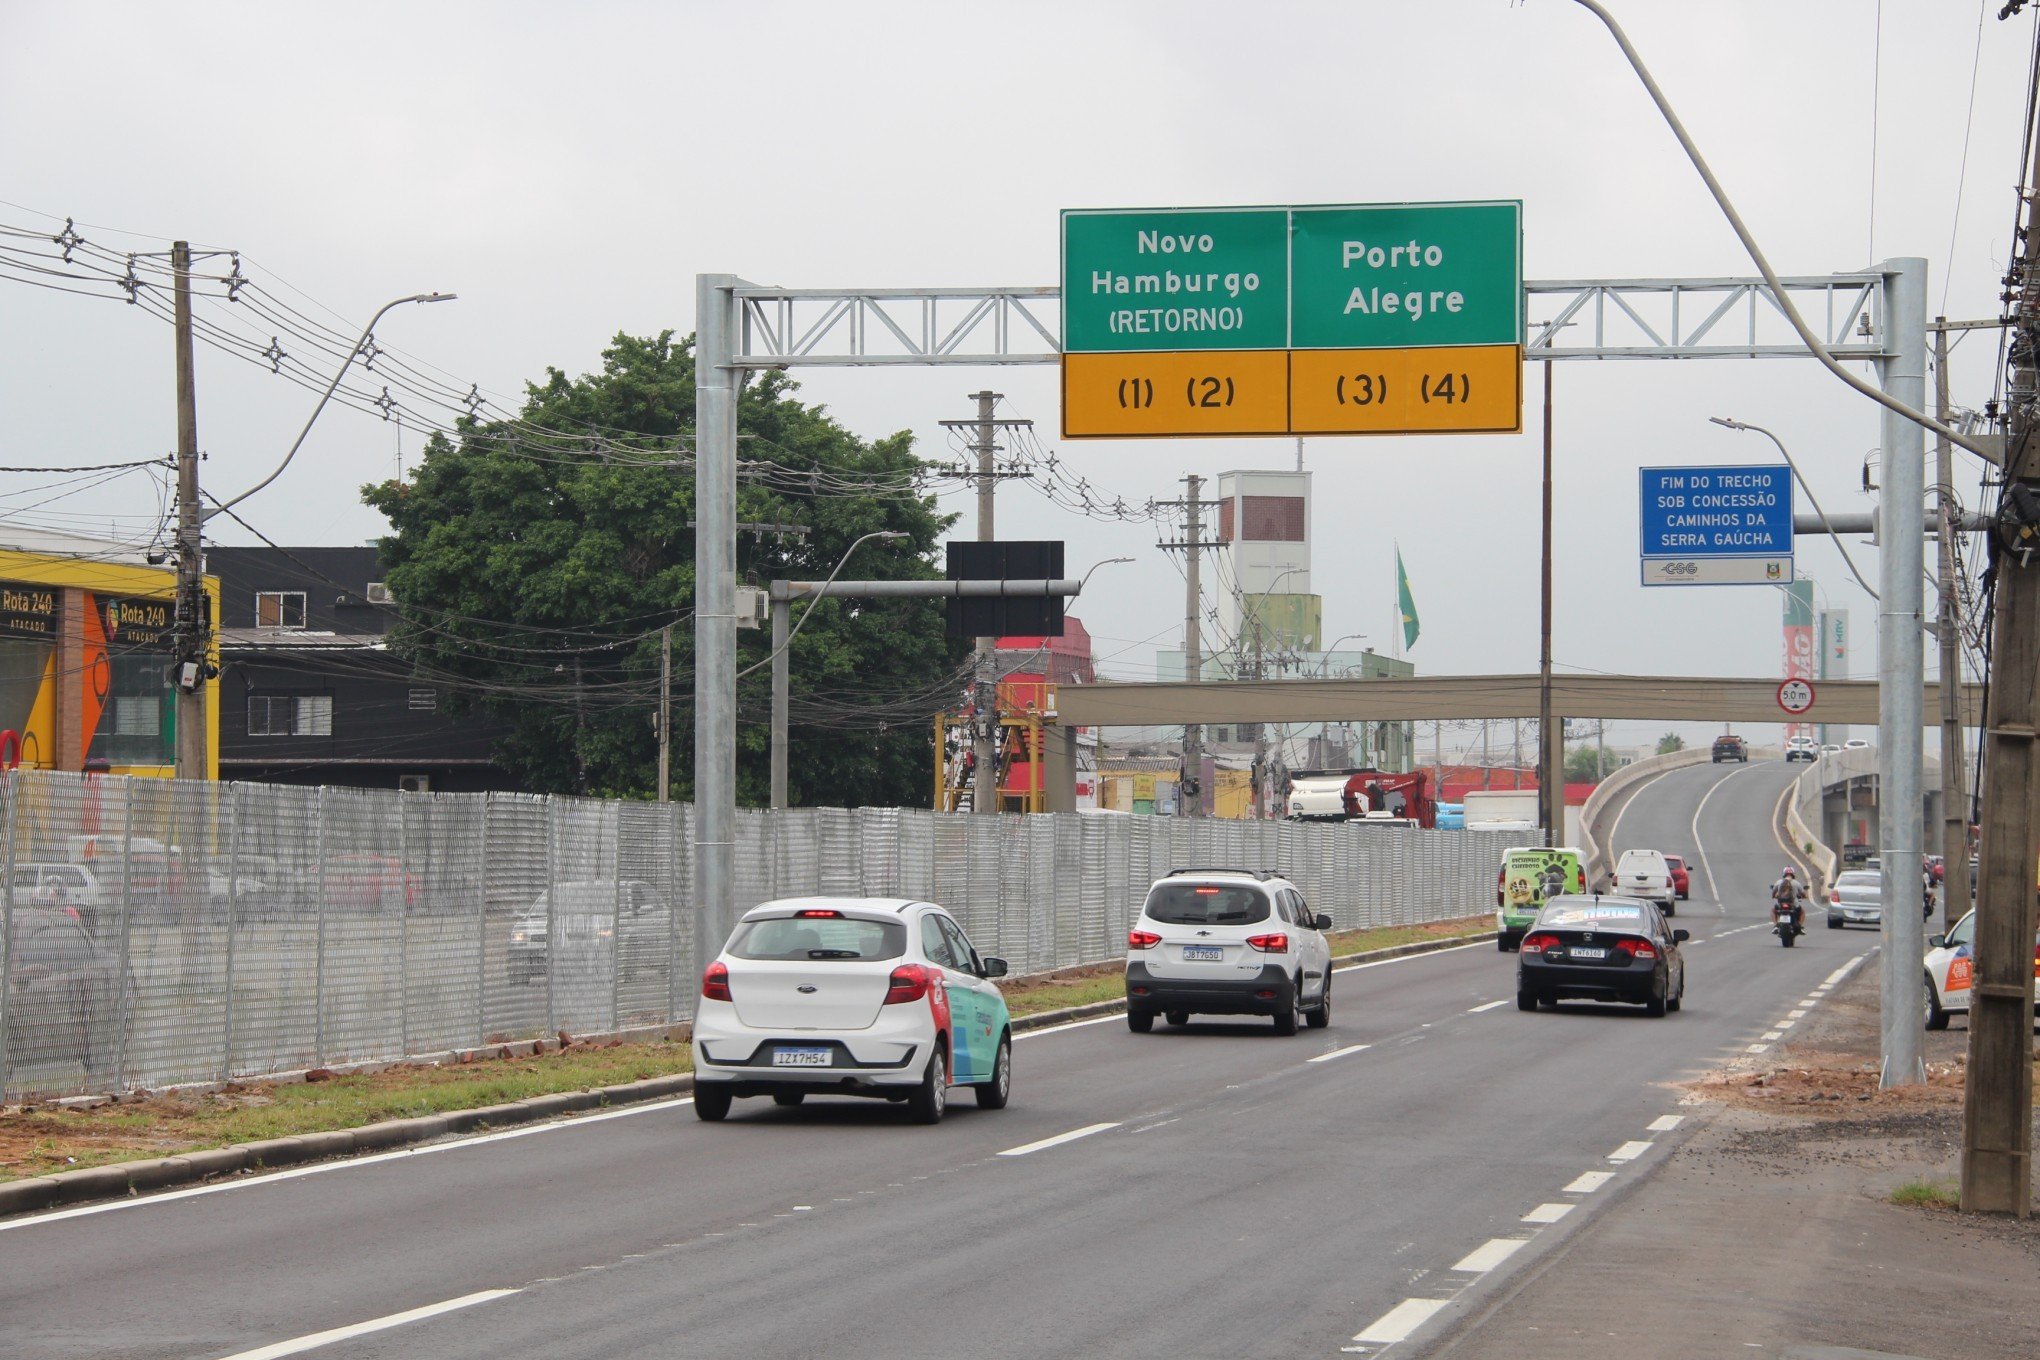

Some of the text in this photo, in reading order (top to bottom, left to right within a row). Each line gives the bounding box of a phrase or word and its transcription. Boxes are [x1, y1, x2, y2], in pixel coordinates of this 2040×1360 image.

[1138, 230, 1214, 254] Novo
[1343, 239, 1443, 269] Porto
[1092, 270, 1260, 298] Hamburgo
[1344, 286, 1465, 322] Alegre
[1109, 306, 1244, 334] (RETORNO)
[1118, 376, 1235, 409] (1) (2)
[1336, 372, 1470, 406] (3) (4)
[1661, 474, 1771, 489] FIM DO TRECHO
[1657, 491, 1776, 508] SOB CONCESSÃO
[1667, 513, 1766, 527] CAMINHOS DA
[1661, 530, 1773, 546] SERRA GAÚCHA
[1664, 562, 1698, 575] CSG
[3, 590, 52, 614] Rota 240
[121, 603, 165, 626] Rota 240
[10, 619, 45, 632] ATACADO
[127, 631, 159, 644] ATACADO
[1798, 691, 1807, 700] m
[778, 1053, 826, 1064] IZX7H54
